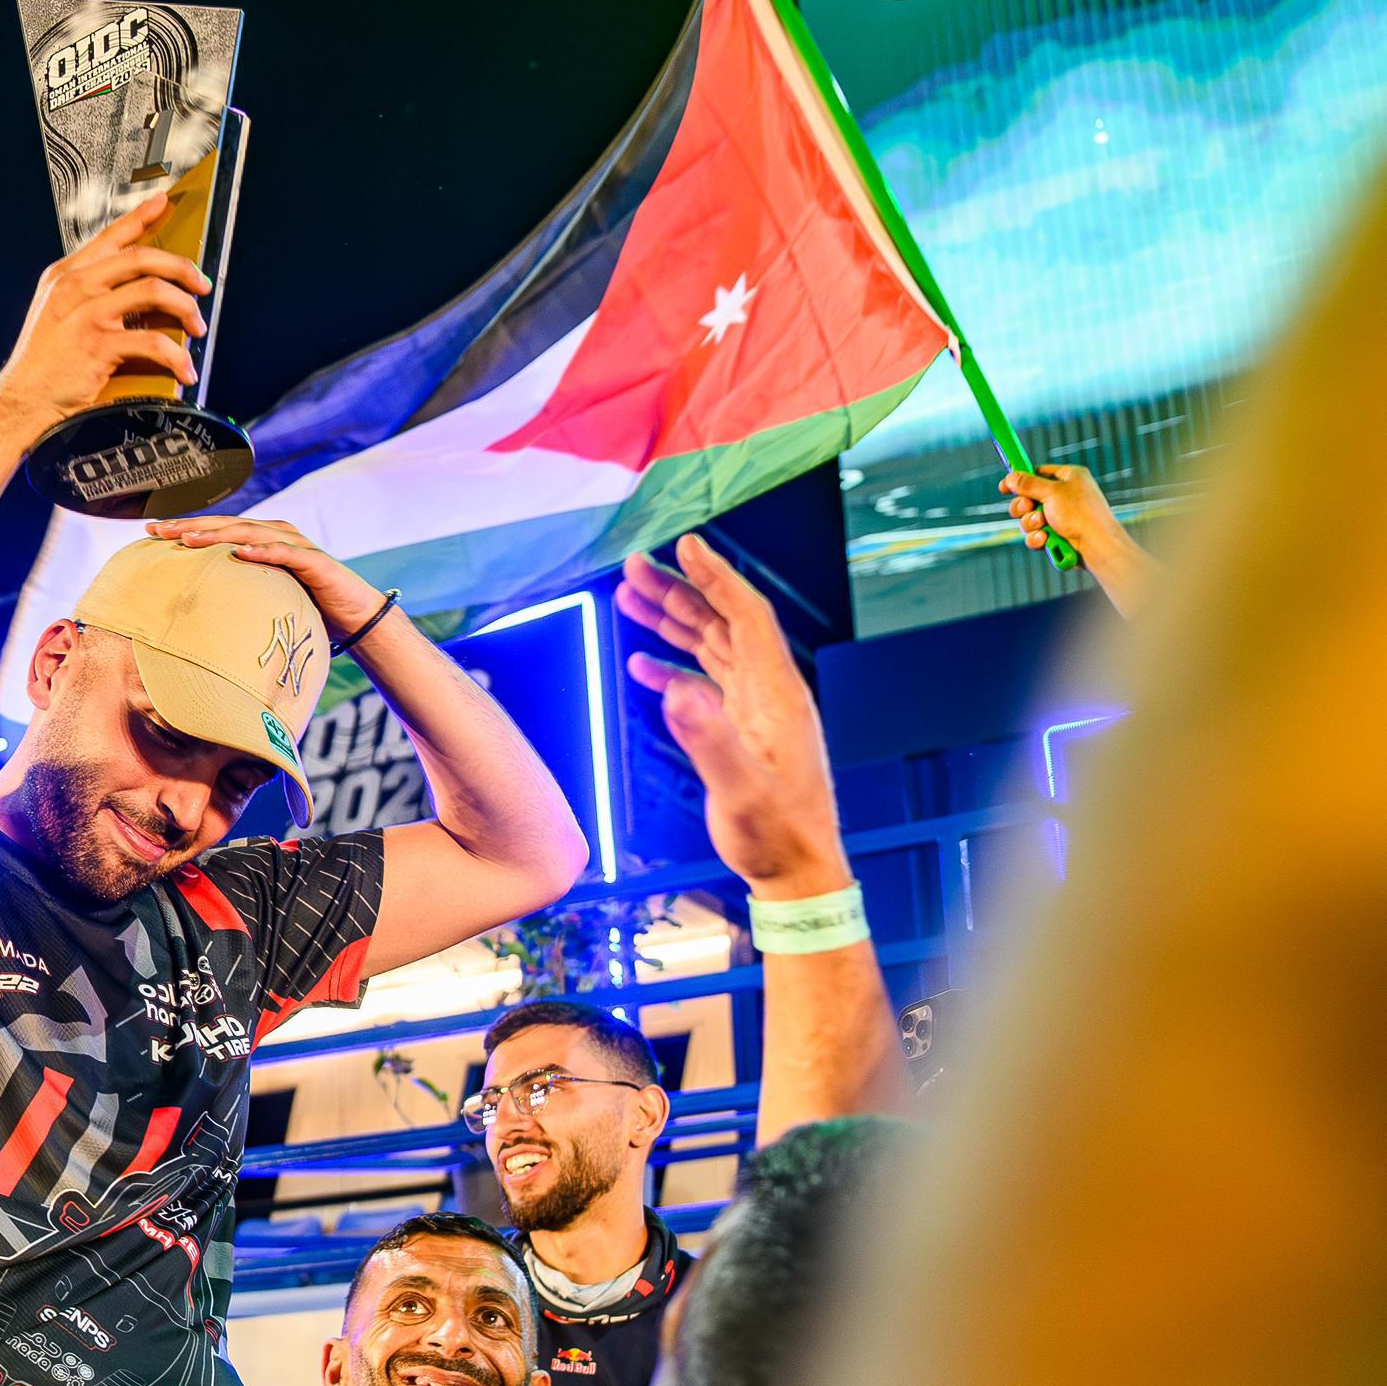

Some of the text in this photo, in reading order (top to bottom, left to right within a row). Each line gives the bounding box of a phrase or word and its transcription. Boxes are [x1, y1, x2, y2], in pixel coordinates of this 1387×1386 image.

[48, 8, 149, 89] OIDC
[49, 41, 150, 99] OMAN INTERNATIONAL
[49, 85, 86, 112] DRIFT
[206, 1039, 251, 1061] TIRE
